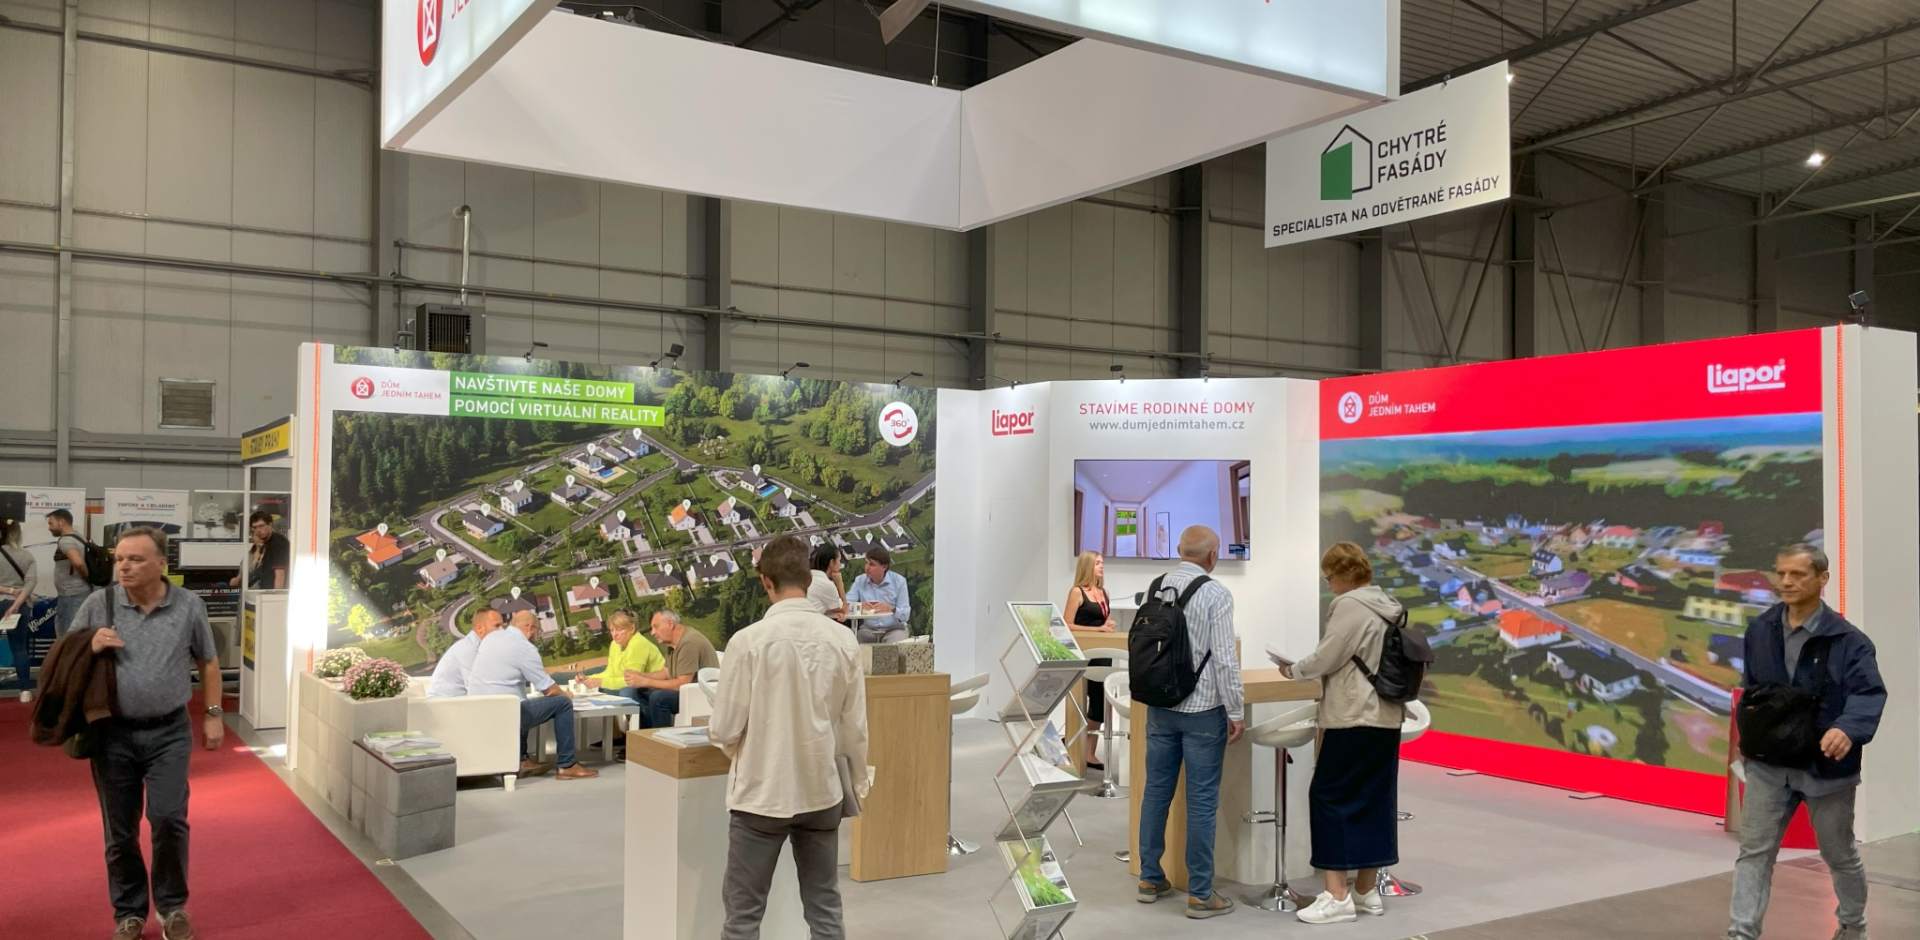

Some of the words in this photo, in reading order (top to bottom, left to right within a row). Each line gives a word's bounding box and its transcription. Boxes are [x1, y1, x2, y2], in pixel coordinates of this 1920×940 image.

[1378, 120, 1447, 159] CHYTRÉ
[1377, 149, 1447, 183] FASÁDY
[1273, 212, 1348, 237] SPECIALISTA
[1352, 207, 1368, 222] NA
[1372, 187, 1445, 217] ODVĚTRANÉ
[1448, 175, 1500, 200] FASÁDY
[455, 375, 537, 394] NAVŠTIVTE
[542, 379, 580, 396] NAŠE
[586, 384, 626, 398] DOMY
[1707, 362, 1786, 394] Liapor
[414, 391, 441, 399] TAHEM
[1079, 400, 1138, 415] STAVÍME
[1143, 399, 1208, 414] RODINNÉ
[1213, 401, 1256, 414] DOMY
[1368, 391, 1389, 405] DŮM
[455, 397, 515, 415] POMOCÍ
[519, 402, 598, 420] VIRTUÁLNÍ
[601, 408, 659, 422] REALITY
[1368, 402, 1402, 417] JEDNÍM
[1404, 402, 1436, 414] TAHEM
[991, 409, 1034, 436] Liapor
[1089, 418, 1245, 432] www.dumjednimtahem.cz
